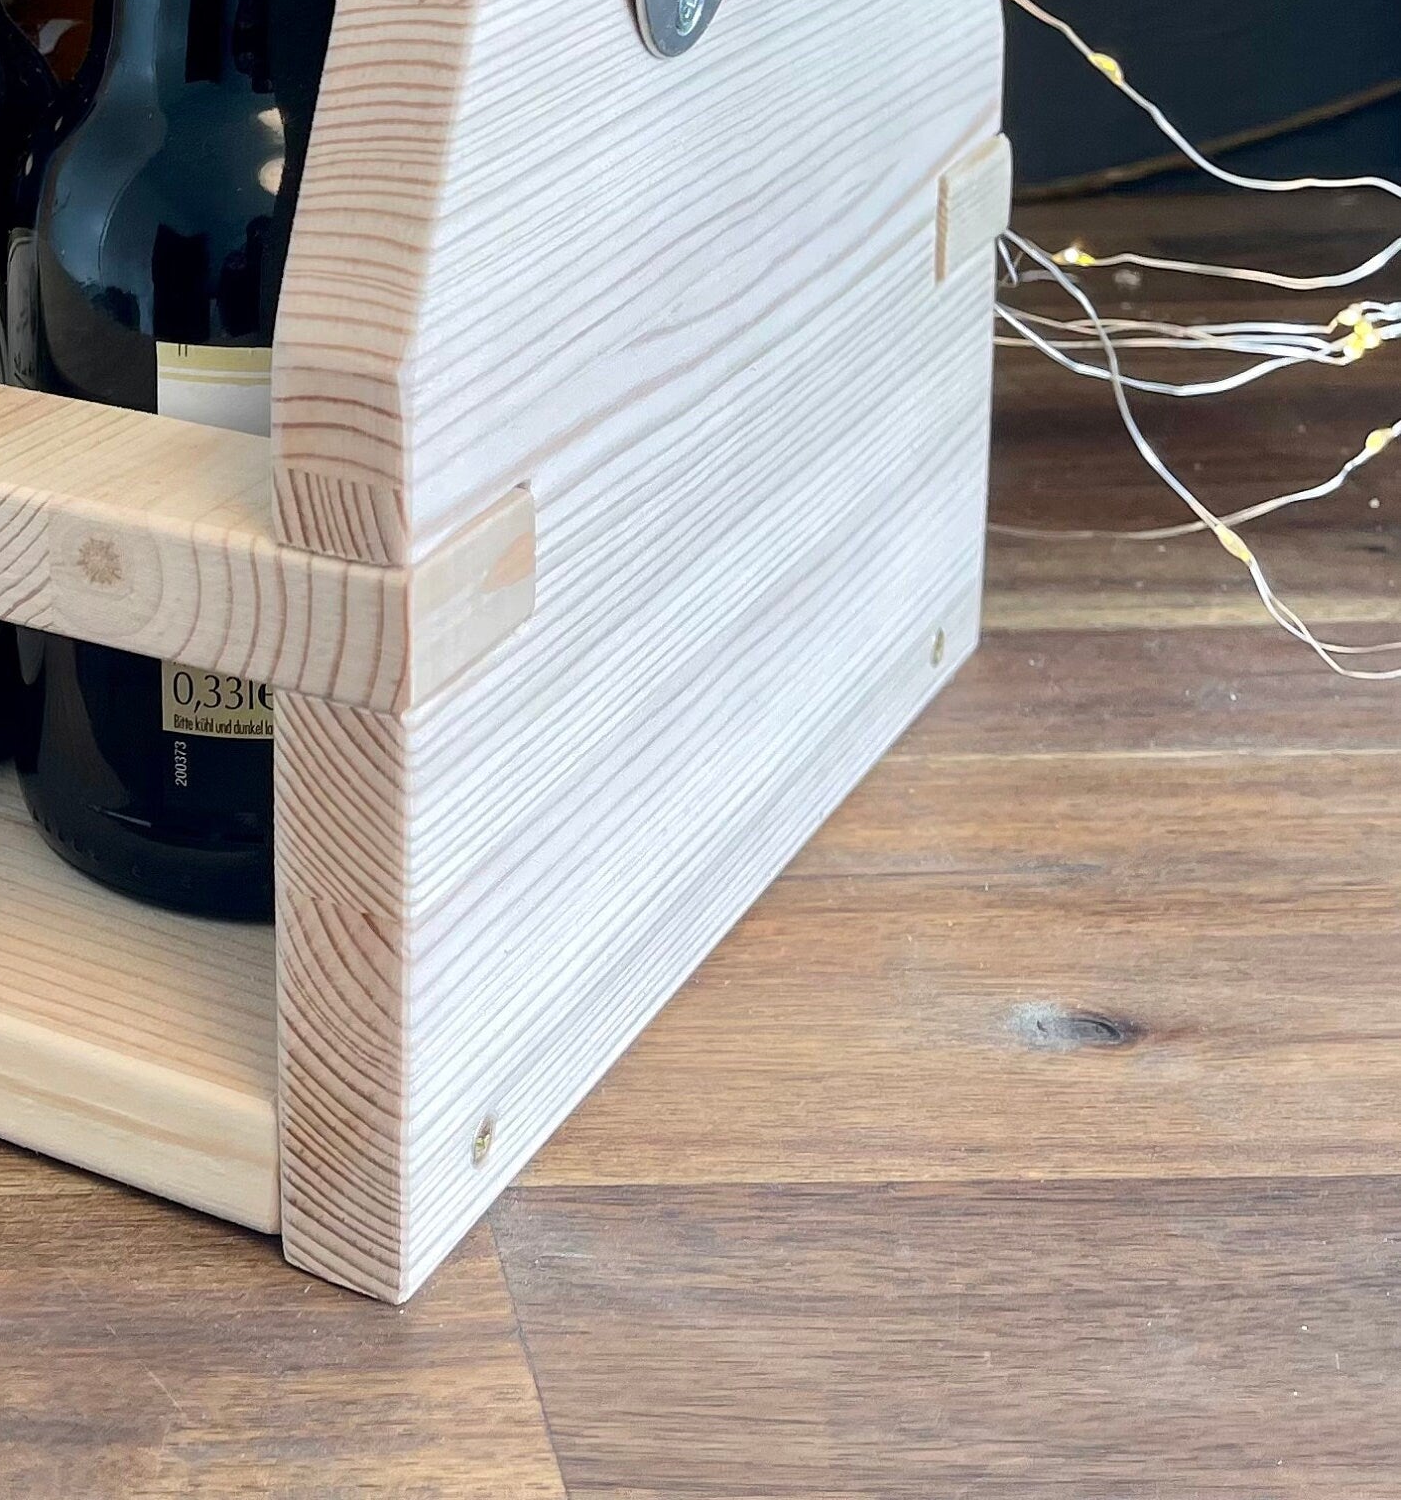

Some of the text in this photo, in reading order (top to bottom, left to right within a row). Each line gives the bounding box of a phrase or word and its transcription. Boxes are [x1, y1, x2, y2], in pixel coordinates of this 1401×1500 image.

[173, 714, 194, 731] Bitte
[194, 715, 214, 732] kühl
[215, 719, 232, 735] und
[233, 719, 264, 735] dunkel
[174, 740, 188, 787] 200373
